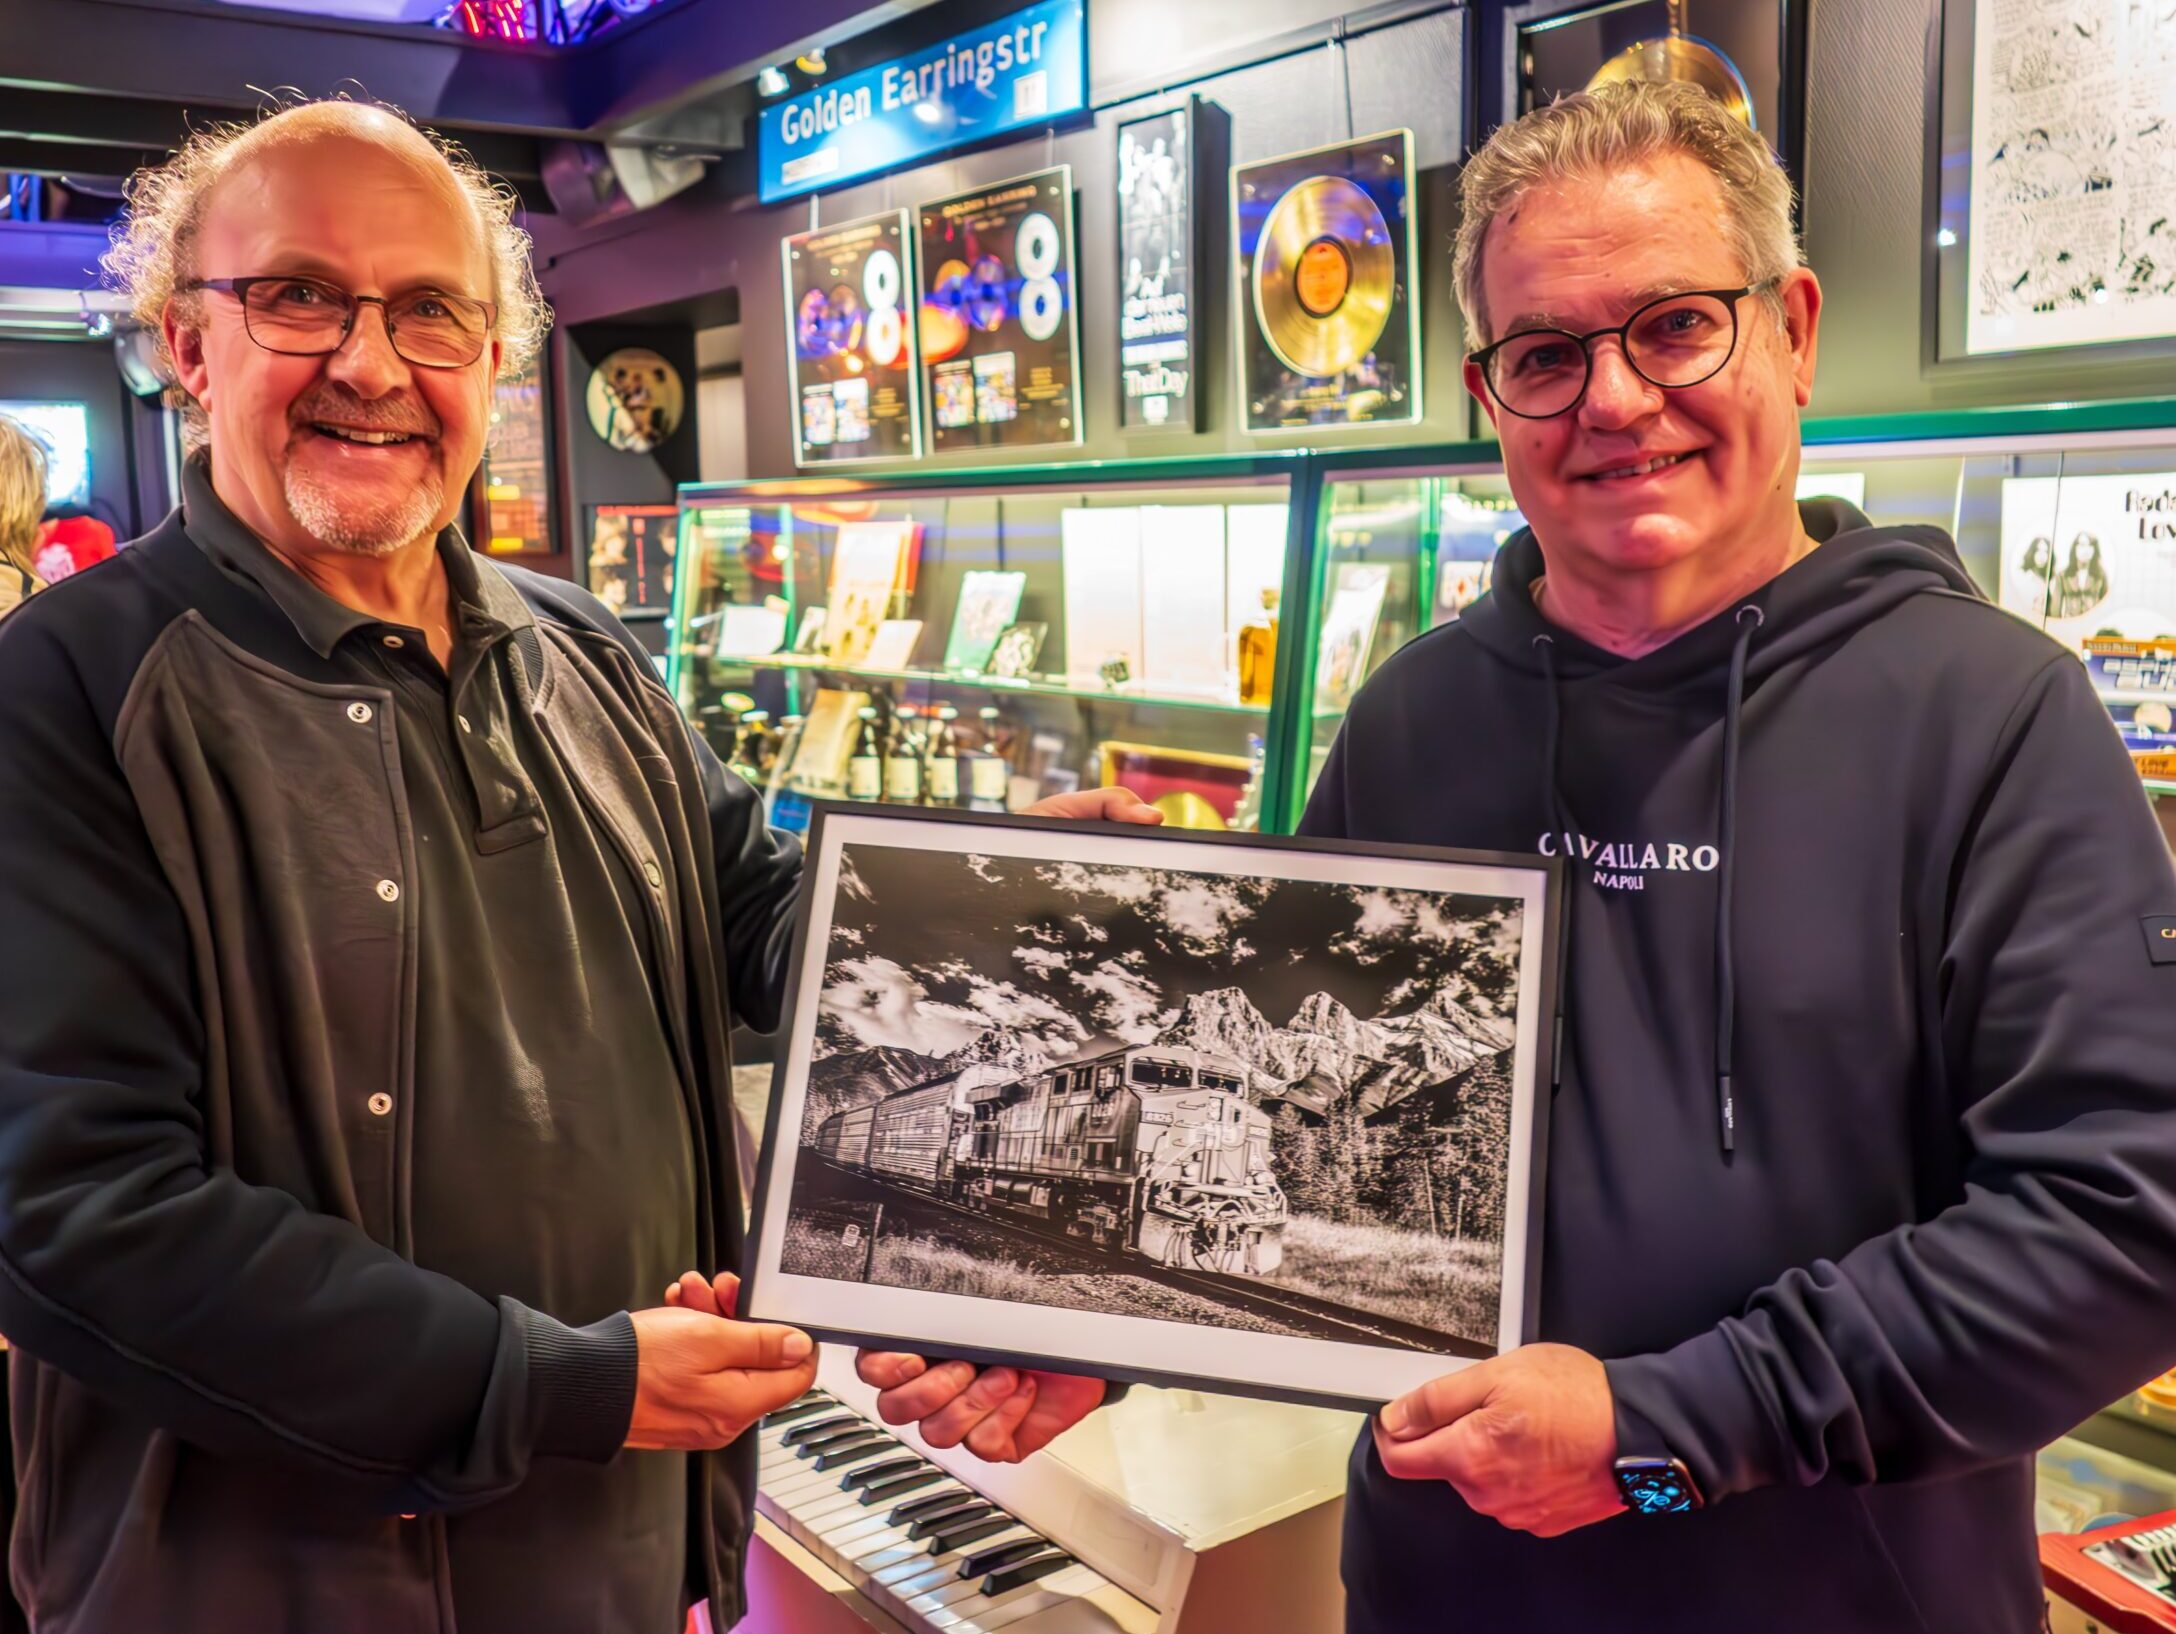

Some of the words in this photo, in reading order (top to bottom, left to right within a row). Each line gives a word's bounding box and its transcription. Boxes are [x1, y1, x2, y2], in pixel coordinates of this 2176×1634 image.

[781, 86, 871, 145] Golden
[882, 20, 1047, 111] Earringstr
[1593, 871, 1644, 891] NAPOLI
